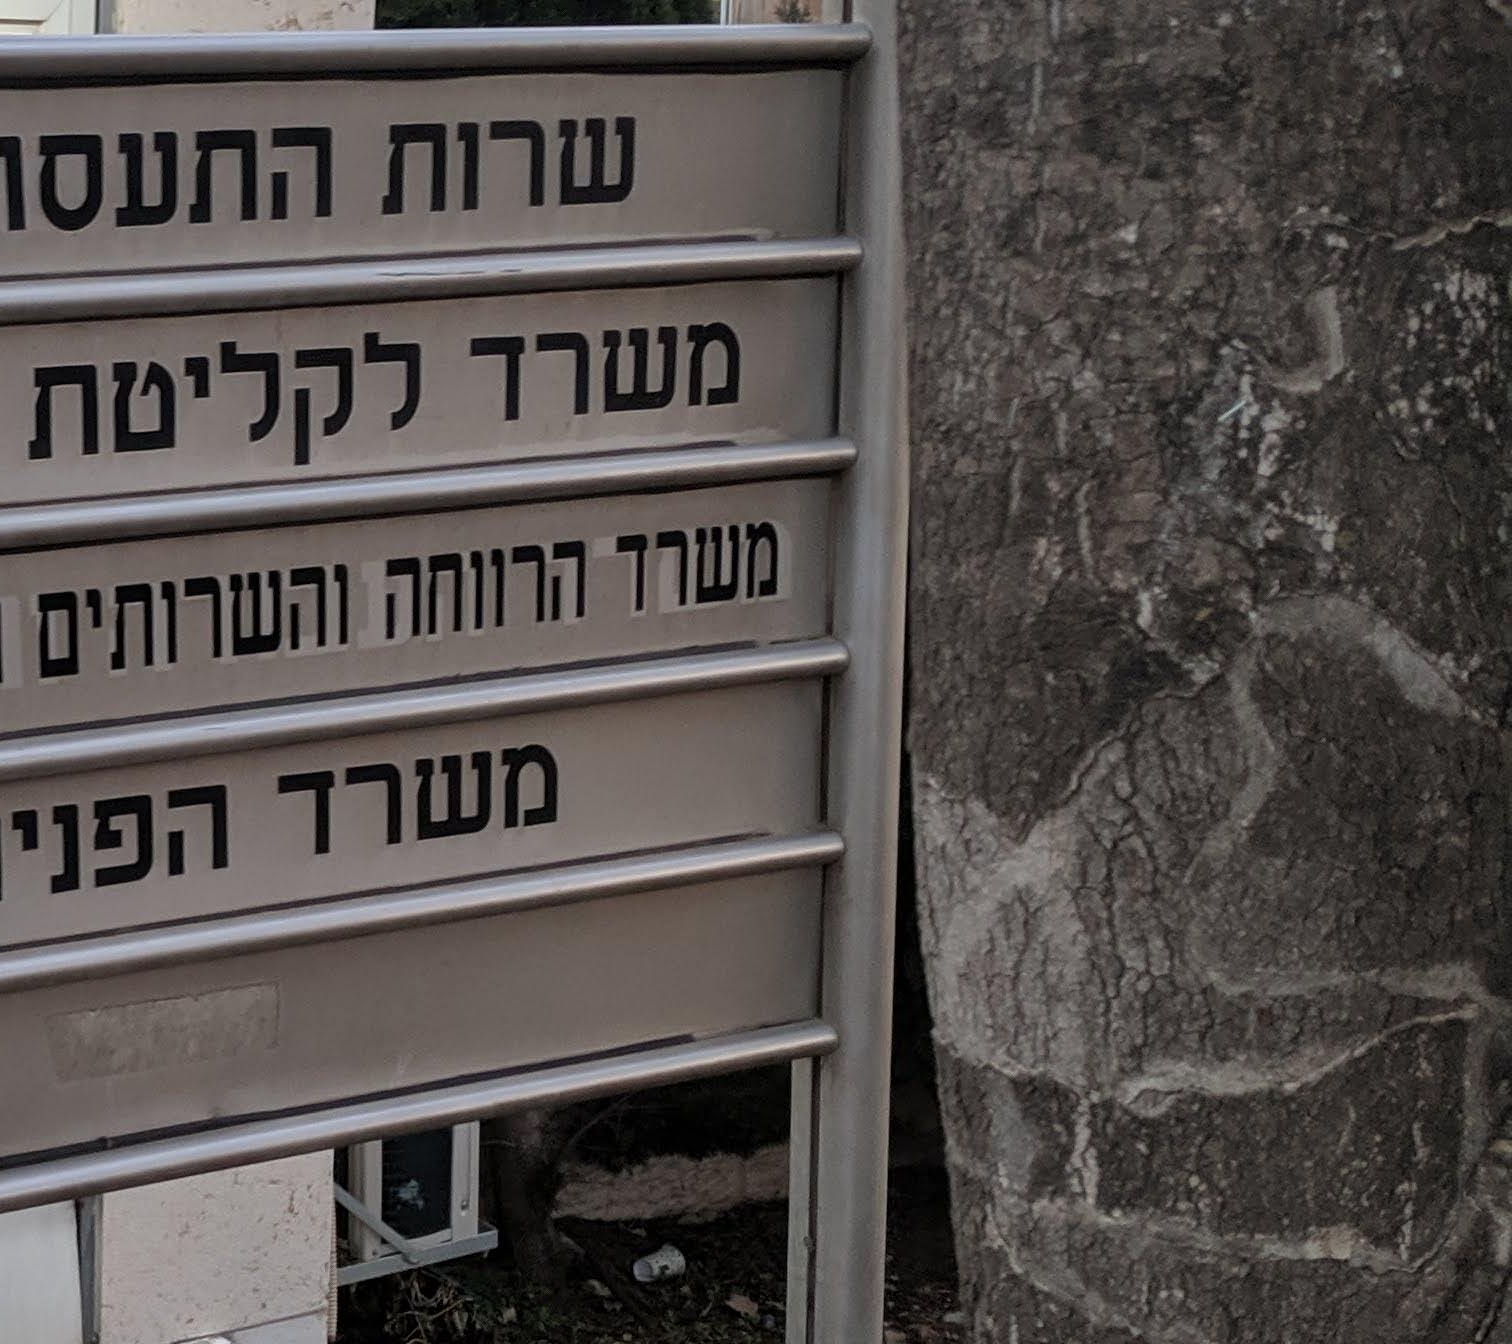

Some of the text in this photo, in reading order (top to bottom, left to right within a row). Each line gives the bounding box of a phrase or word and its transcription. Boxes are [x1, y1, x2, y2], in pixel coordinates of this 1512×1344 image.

[381, 115, 637, 216] שרות
[27, 331, 422, 467] לקליטת
[469, 320, 742, 422] משרד
[384, 539, 587, 641] הרווחה
[616, 520, 780, 613] משרד
[37, 562, 350, 680] והשרותים
[277, 743, 560, 856] משרד
